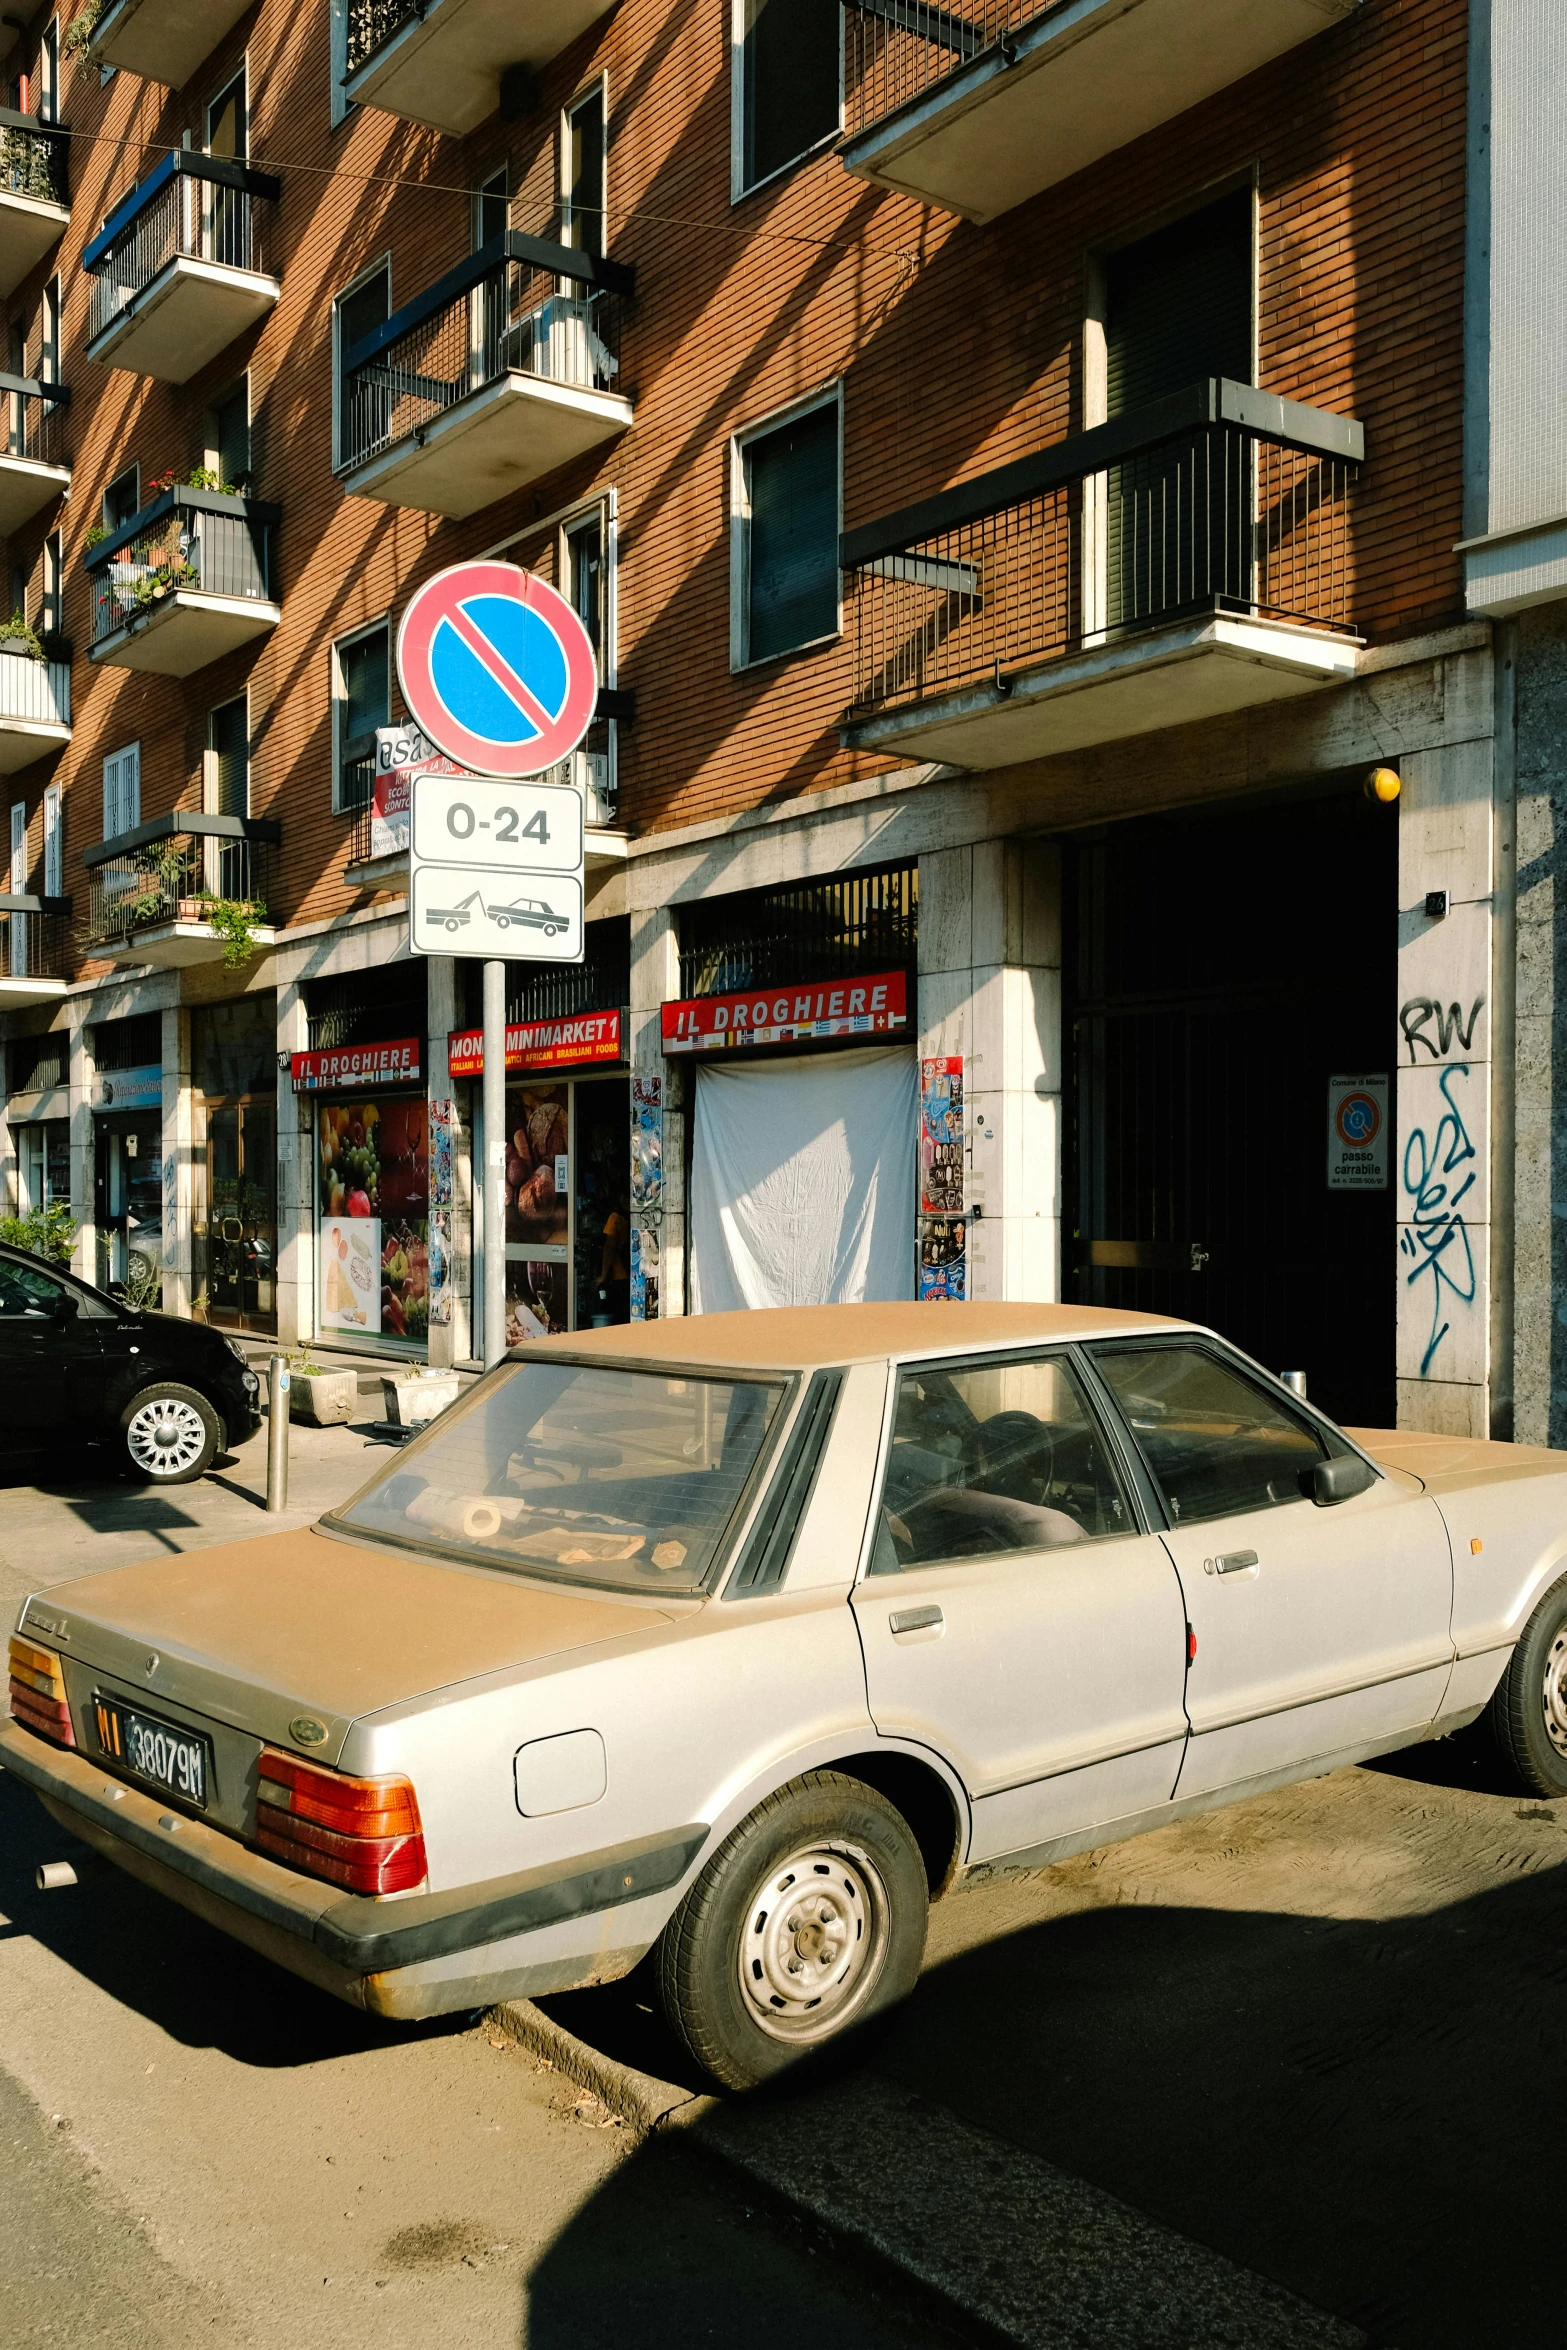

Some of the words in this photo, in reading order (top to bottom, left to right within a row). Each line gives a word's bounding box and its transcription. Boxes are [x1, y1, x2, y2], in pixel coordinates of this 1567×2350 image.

[446, 802, 551, 845] 0-24
[1429, 897, 1444, 911] 26
[677, 1010, 700, 1035] IL
[714, 985, 888, 1030] DROGHIERE
[451, 1036, 484, 1058] MON
[507, 1018, 607, 1051] MINIMARKET
[609, 1016, 618, 1039] 1
[279, 1053, 287, 1067] 28
[301, 1060, 313, 1077] IL
[320, 1048, 411, 1075] DROGHIERE
[451, 1060, 473, 1071] ITALIANI
[525, 1052, 553, 1063] AFRICANI
[557, 1046, 592, 1059] BRASILIANI
[596, 1043, 618, 1054] FOODS
[1332, 1079, 1356, 1087] Comune
[1366, 1078, 1386, 1086] Milano
[1335, 1164, 1380, 1175] carrabile
[1342, 1152, 1374, 1164] passo
[97, 1705, 120, 1756] MI
[134, 1725, 203, 1797] 38079M
